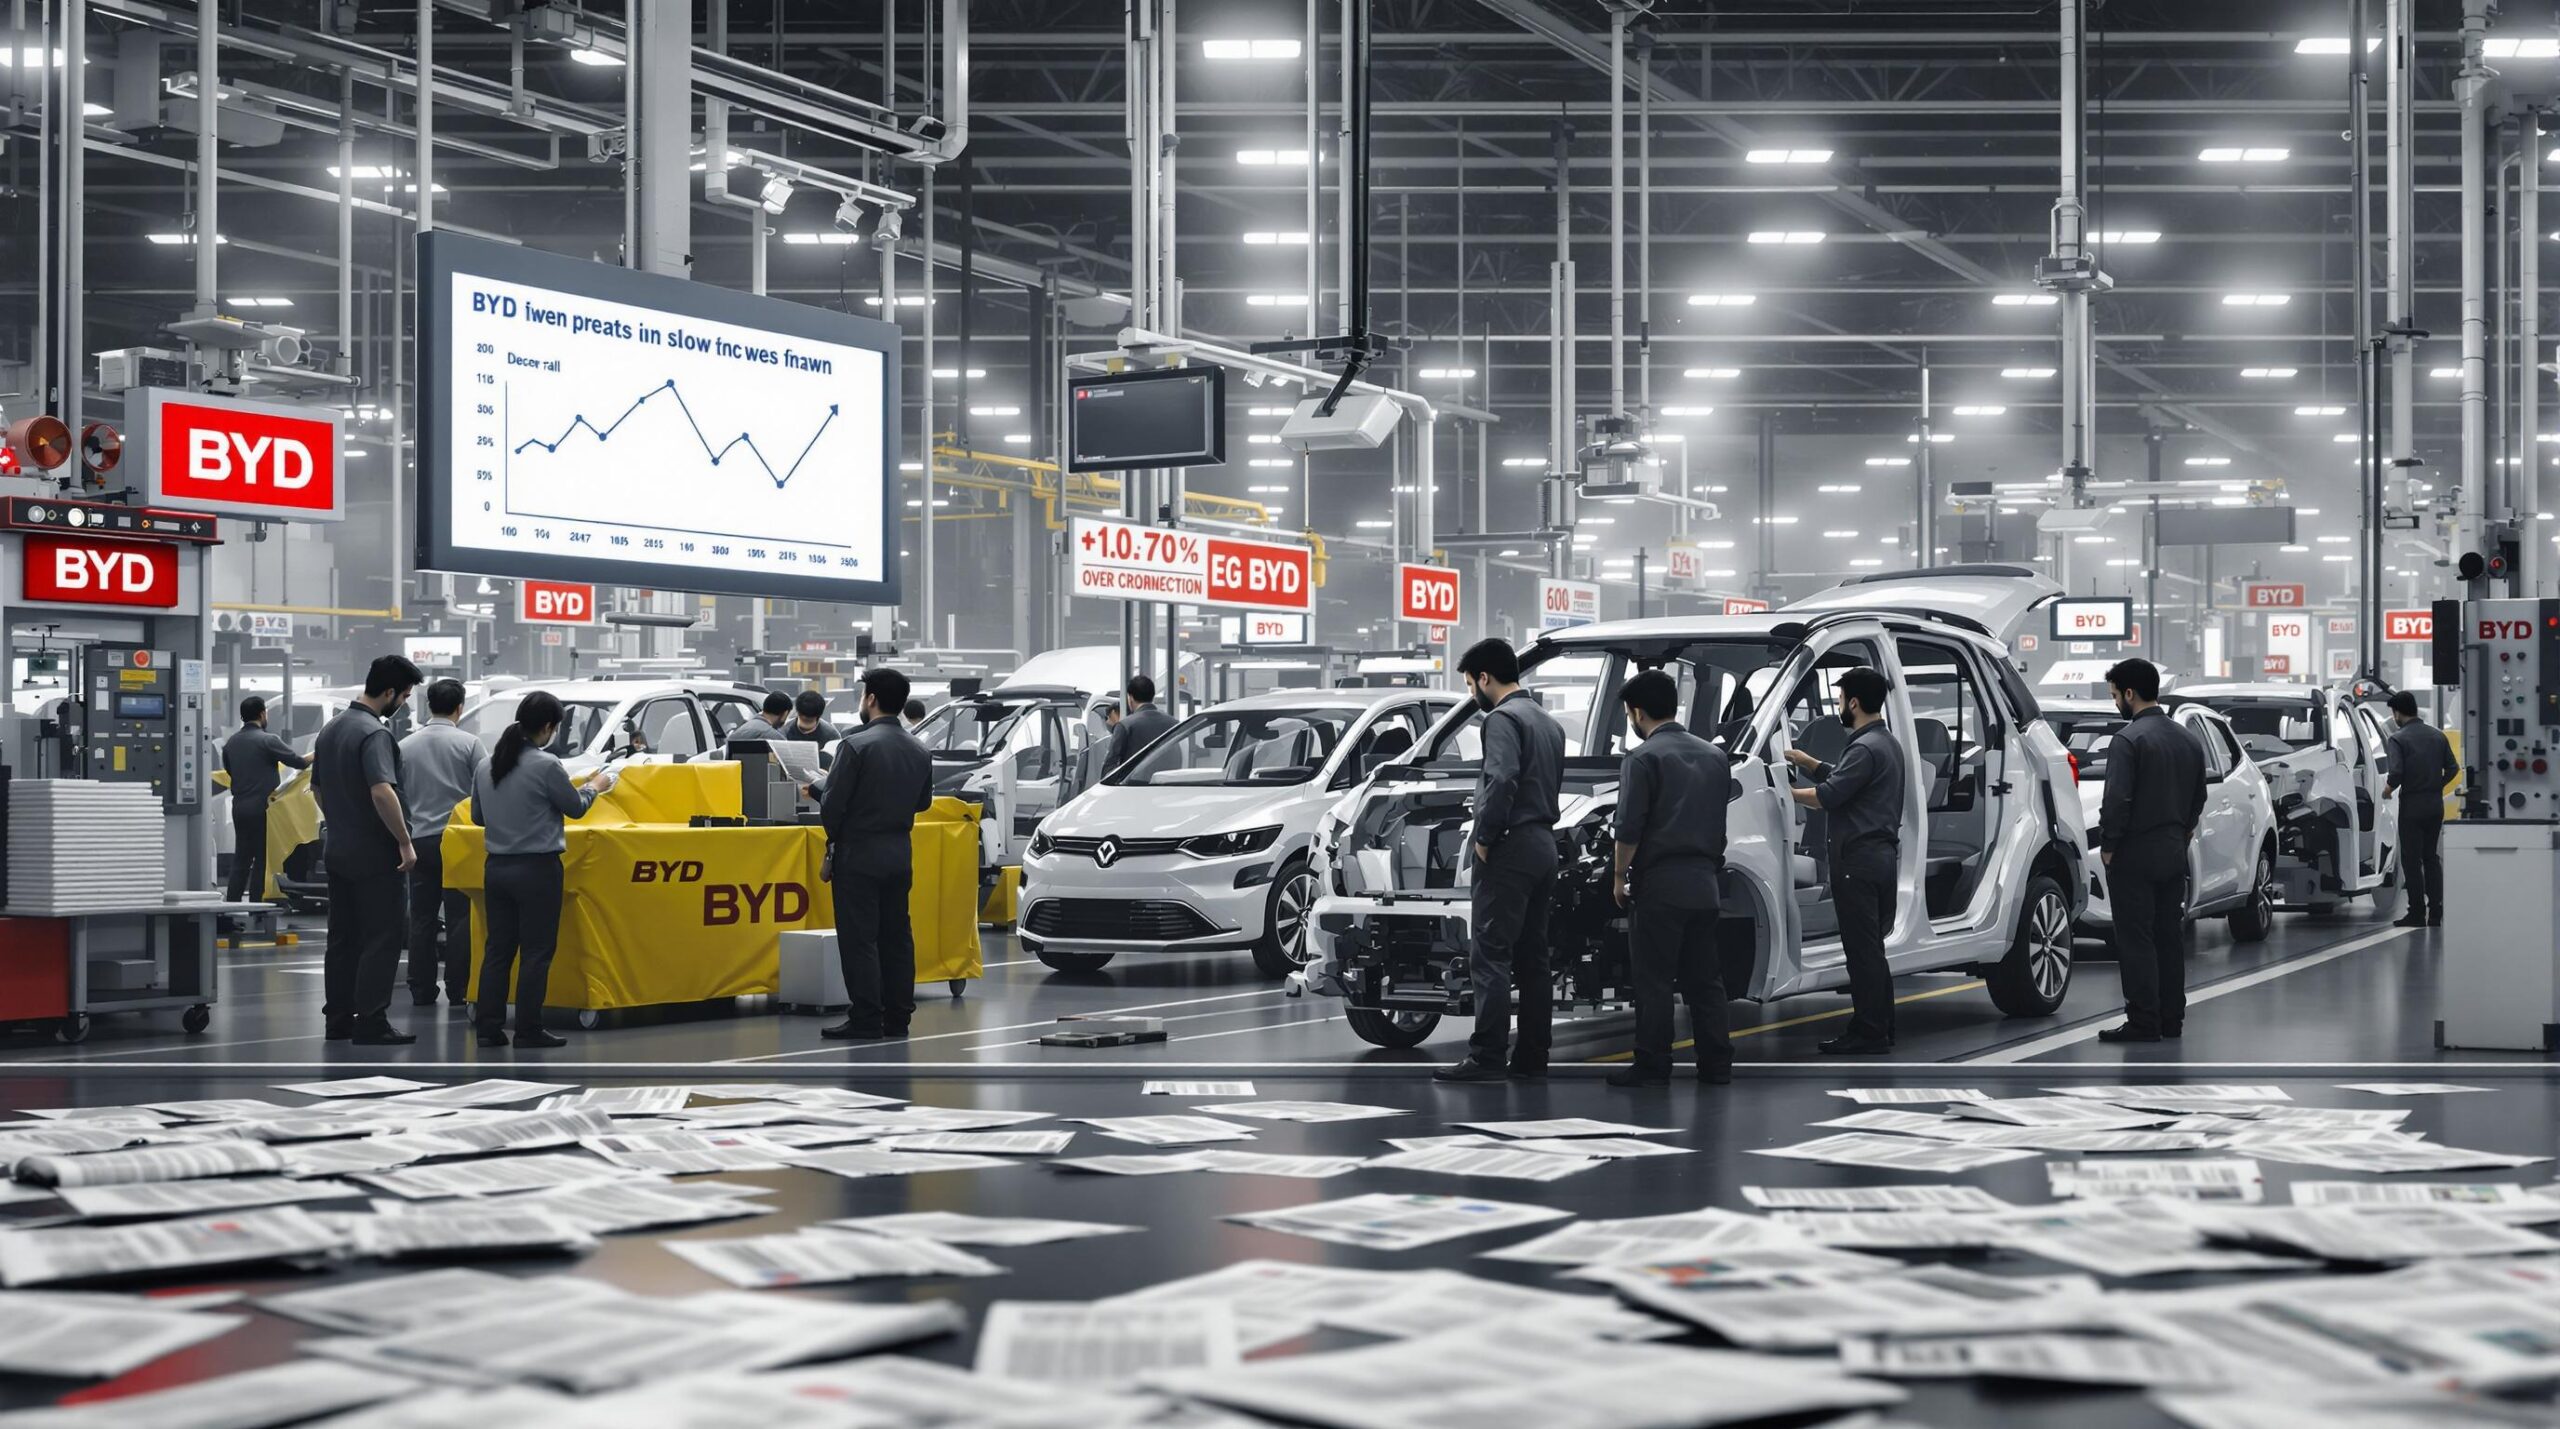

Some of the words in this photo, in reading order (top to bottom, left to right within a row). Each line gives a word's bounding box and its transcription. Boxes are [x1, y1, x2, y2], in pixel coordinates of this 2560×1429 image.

[473, 292, 517, 318] BYD
[572, 312, 633, 340] preats
[668, 329, 712, 353] slow
[744, 346, 779, 365] wes
[188, 427, 314, 490] BYD
[483, 500, 491, 512] 0
[55, 547, 154, 593] BYD
[1082, 570, 1115, 588] OVER
[1211, 553, 1242, 590] EG
[1248, 558, 1300, 594] BYD
[535, 590, 584, 616] BYD
[1411, 579, 1455, 613] BYD
[2257, 589, 2294, 604] BYD
[1256, 622, 1284, 636] BYD
[2075, 615, 2106, 627] BYD
[2272, 624, 2301, 637] BYD
[2392, 617, 2432, 635] BYD
[2479, 620, 2533, 640] BYD
[631, 860, 704, 883] BYD
[703, 882, 810, 926] BYD
